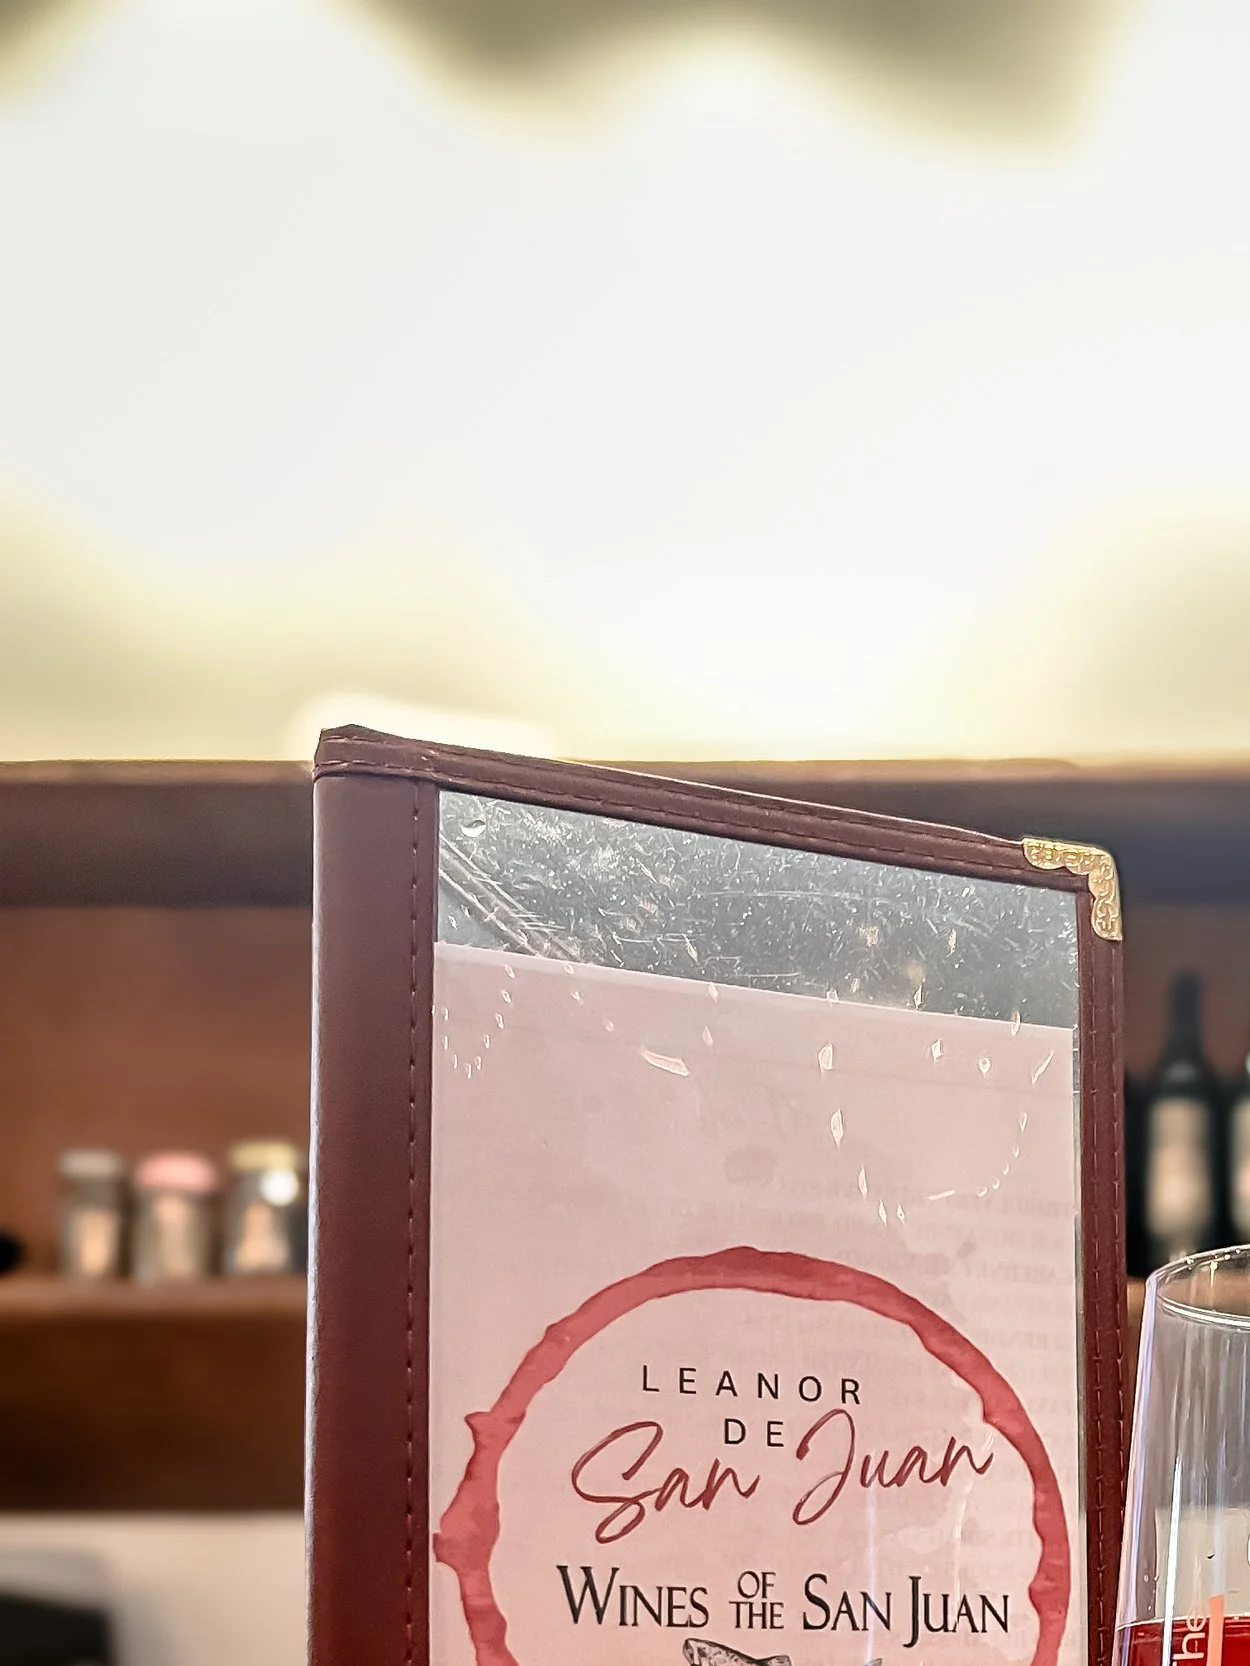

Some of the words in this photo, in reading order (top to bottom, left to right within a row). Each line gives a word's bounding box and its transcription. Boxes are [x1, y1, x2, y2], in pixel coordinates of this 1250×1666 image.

[642, 1364, 863, 1405] LEANOR
[723, 1417, 786, 1448] DE
[571, 1421, 760, 1544] San
[795, 1409, 994, 1525] Juan
[556, 1564, 709, 1629] WINES
[737, 1570, 776, 1600] OF
[801, 1573, 892, 1633] SAN
[729, 1600, 785, 1631] THE
[903, 1576, 1010, 1648] JUAN
